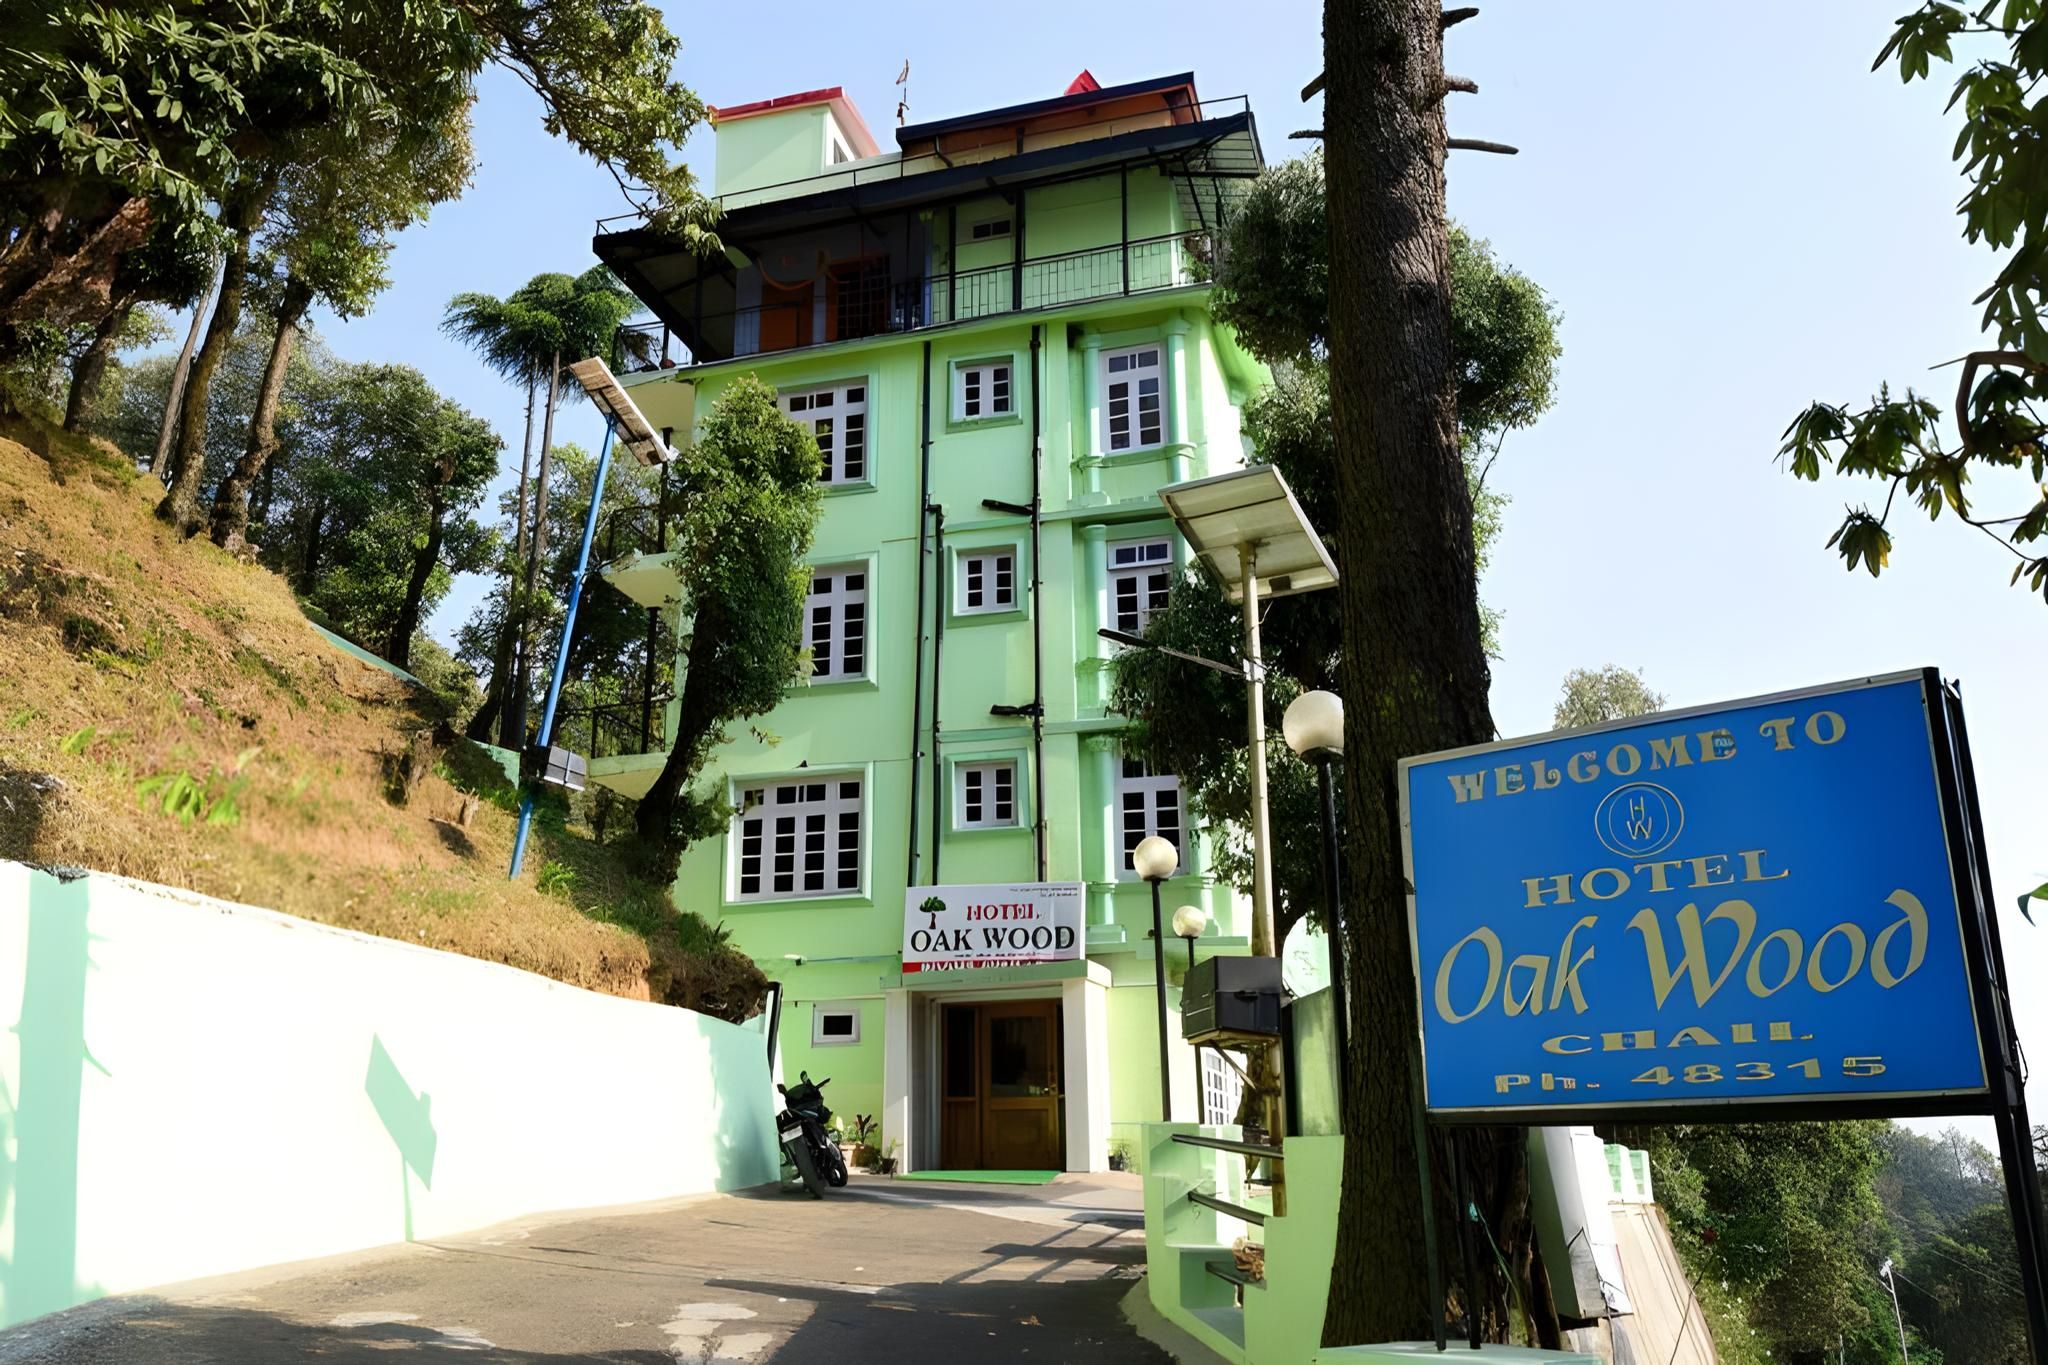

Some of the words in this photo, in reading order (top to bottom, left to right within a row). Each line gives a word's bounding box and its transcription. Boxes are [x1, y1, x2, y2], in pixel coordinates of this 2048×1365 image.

[1447, 728, 1737, 804] WELCOME
[1759, 710, 1847, 752] TO
[1521, 849, 1791, 908] HOTEL
[910, 928, 974, 953] OAK
[982, 925, 1076, 950] WOOD
[1434, 914, 1599, 1024] Oak
[1624, 888, 1929, 1011] Wood
[1541, 1020, 1814, 1055] CHAIL
[1630, 1055, 1887, 1085] 48315
